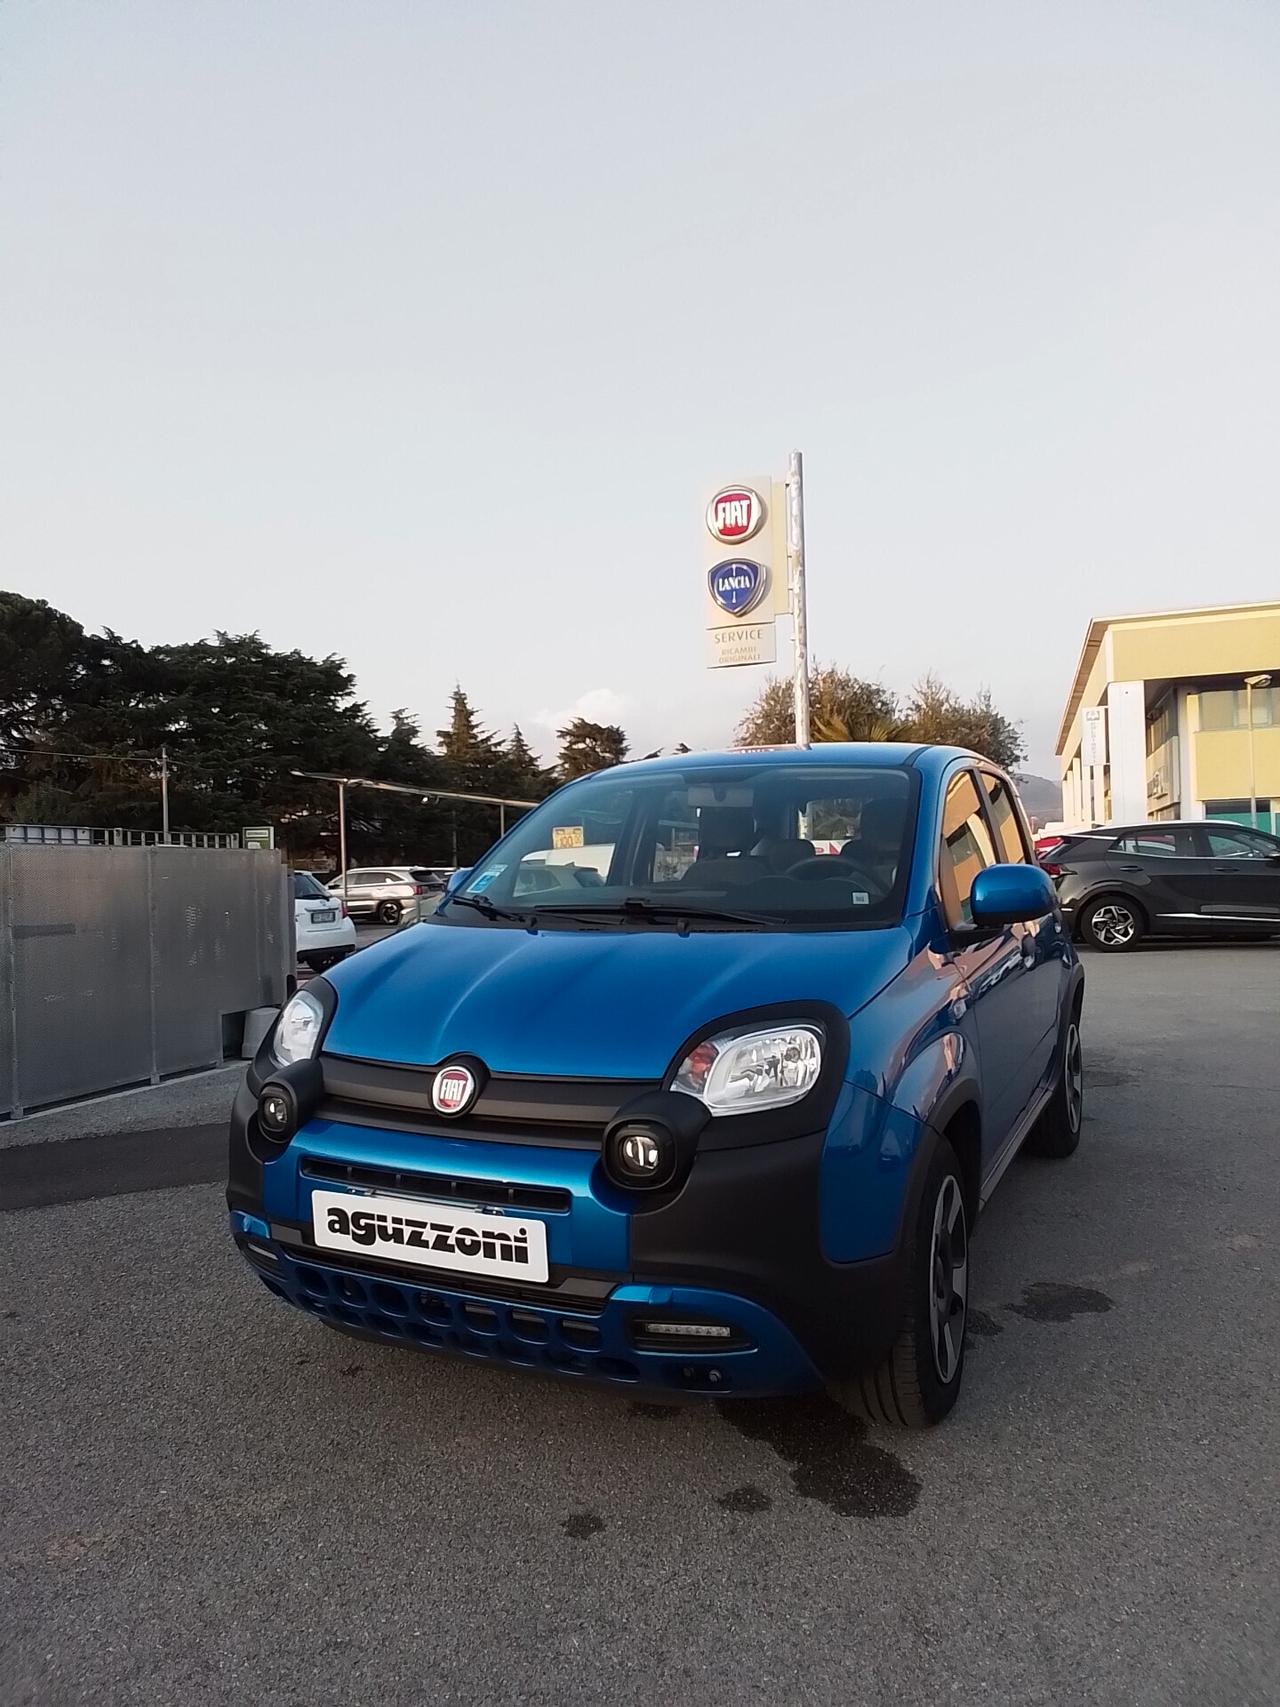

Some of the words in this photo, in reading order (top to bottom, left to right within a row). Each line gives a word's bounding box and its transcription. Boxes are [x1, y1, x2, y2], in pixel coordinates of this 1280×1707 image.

[717, 499, 750, 530] FIAT
[719, 575, 750, 592] LANCIA
[714, 629, 763, 644] SERVICE
[440, 1078, 466, 1101] FIAT
[327, 1207, 529, 1264] aguzzoni
